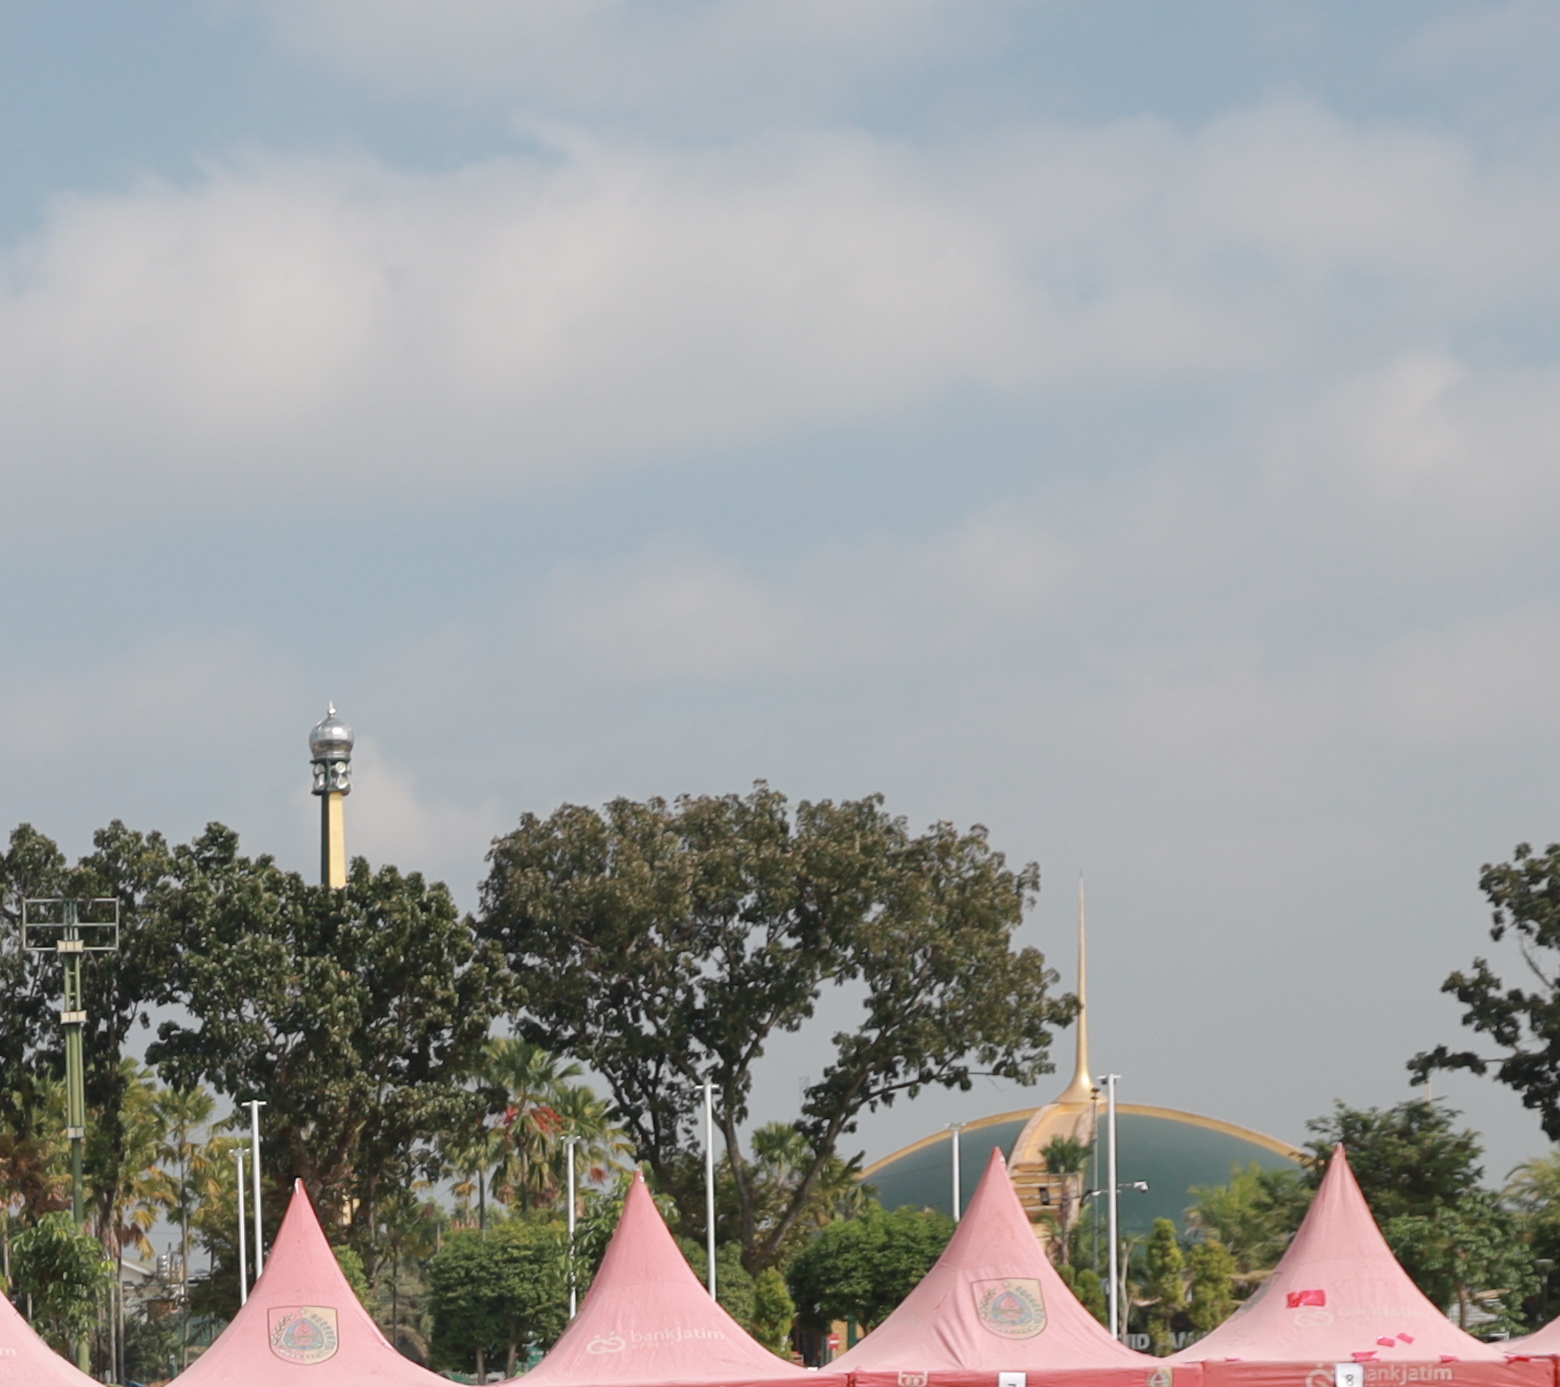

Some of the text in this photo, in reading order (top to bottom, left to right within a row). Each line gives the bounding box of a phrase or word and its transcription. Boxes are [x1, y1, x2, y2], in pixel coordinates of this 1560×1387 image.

[631, 1326, 725, 1342] bankjatim
[1346, 1374, 1355, 1387] 8
[1364, 1365, 1453, 1385] ankjatim
